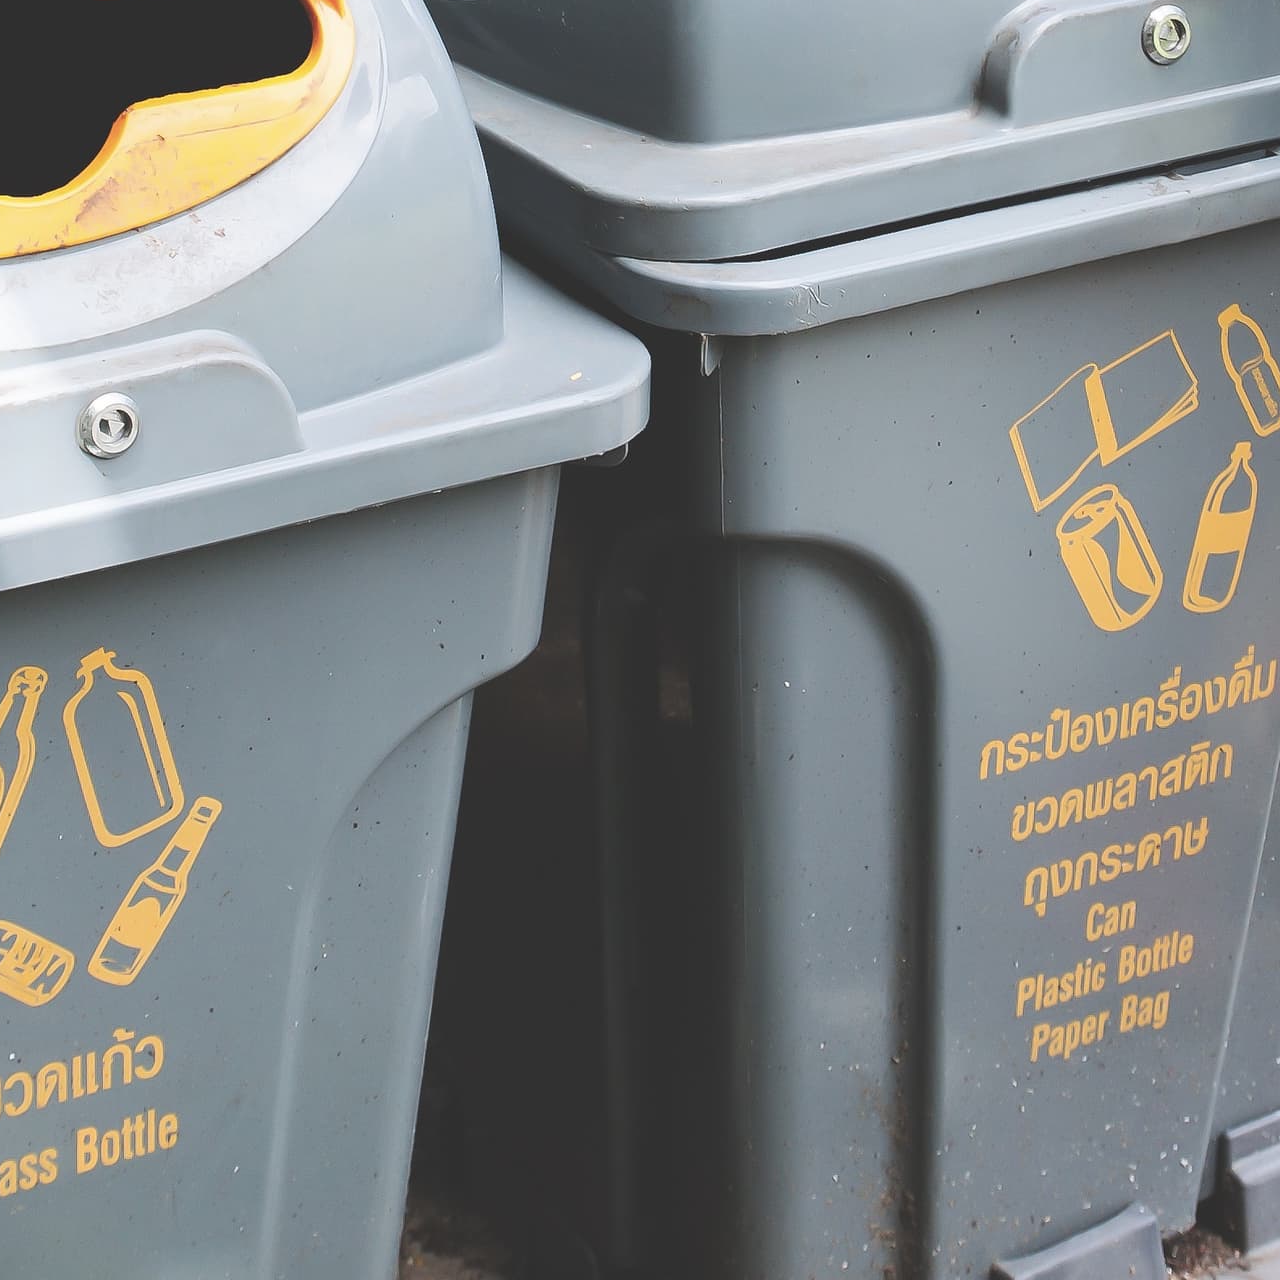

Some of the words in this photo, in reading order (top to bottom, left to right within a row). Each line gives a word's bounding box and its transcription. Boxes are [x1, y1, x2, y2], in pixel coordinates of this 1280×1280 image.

[1011, 741, 1233, 841] ขวดพลาสติก
[1085, 900, 1137, 942] Can
[1016, 957, 1107, 1017] Plastic
[1117, 930, 1195, 984] Bottle
[1030, 1010, 1110, 1062] Paper
[1119, 990, 1170, 1033] Bag
[75, 1108, 179, 1174] Bottle
